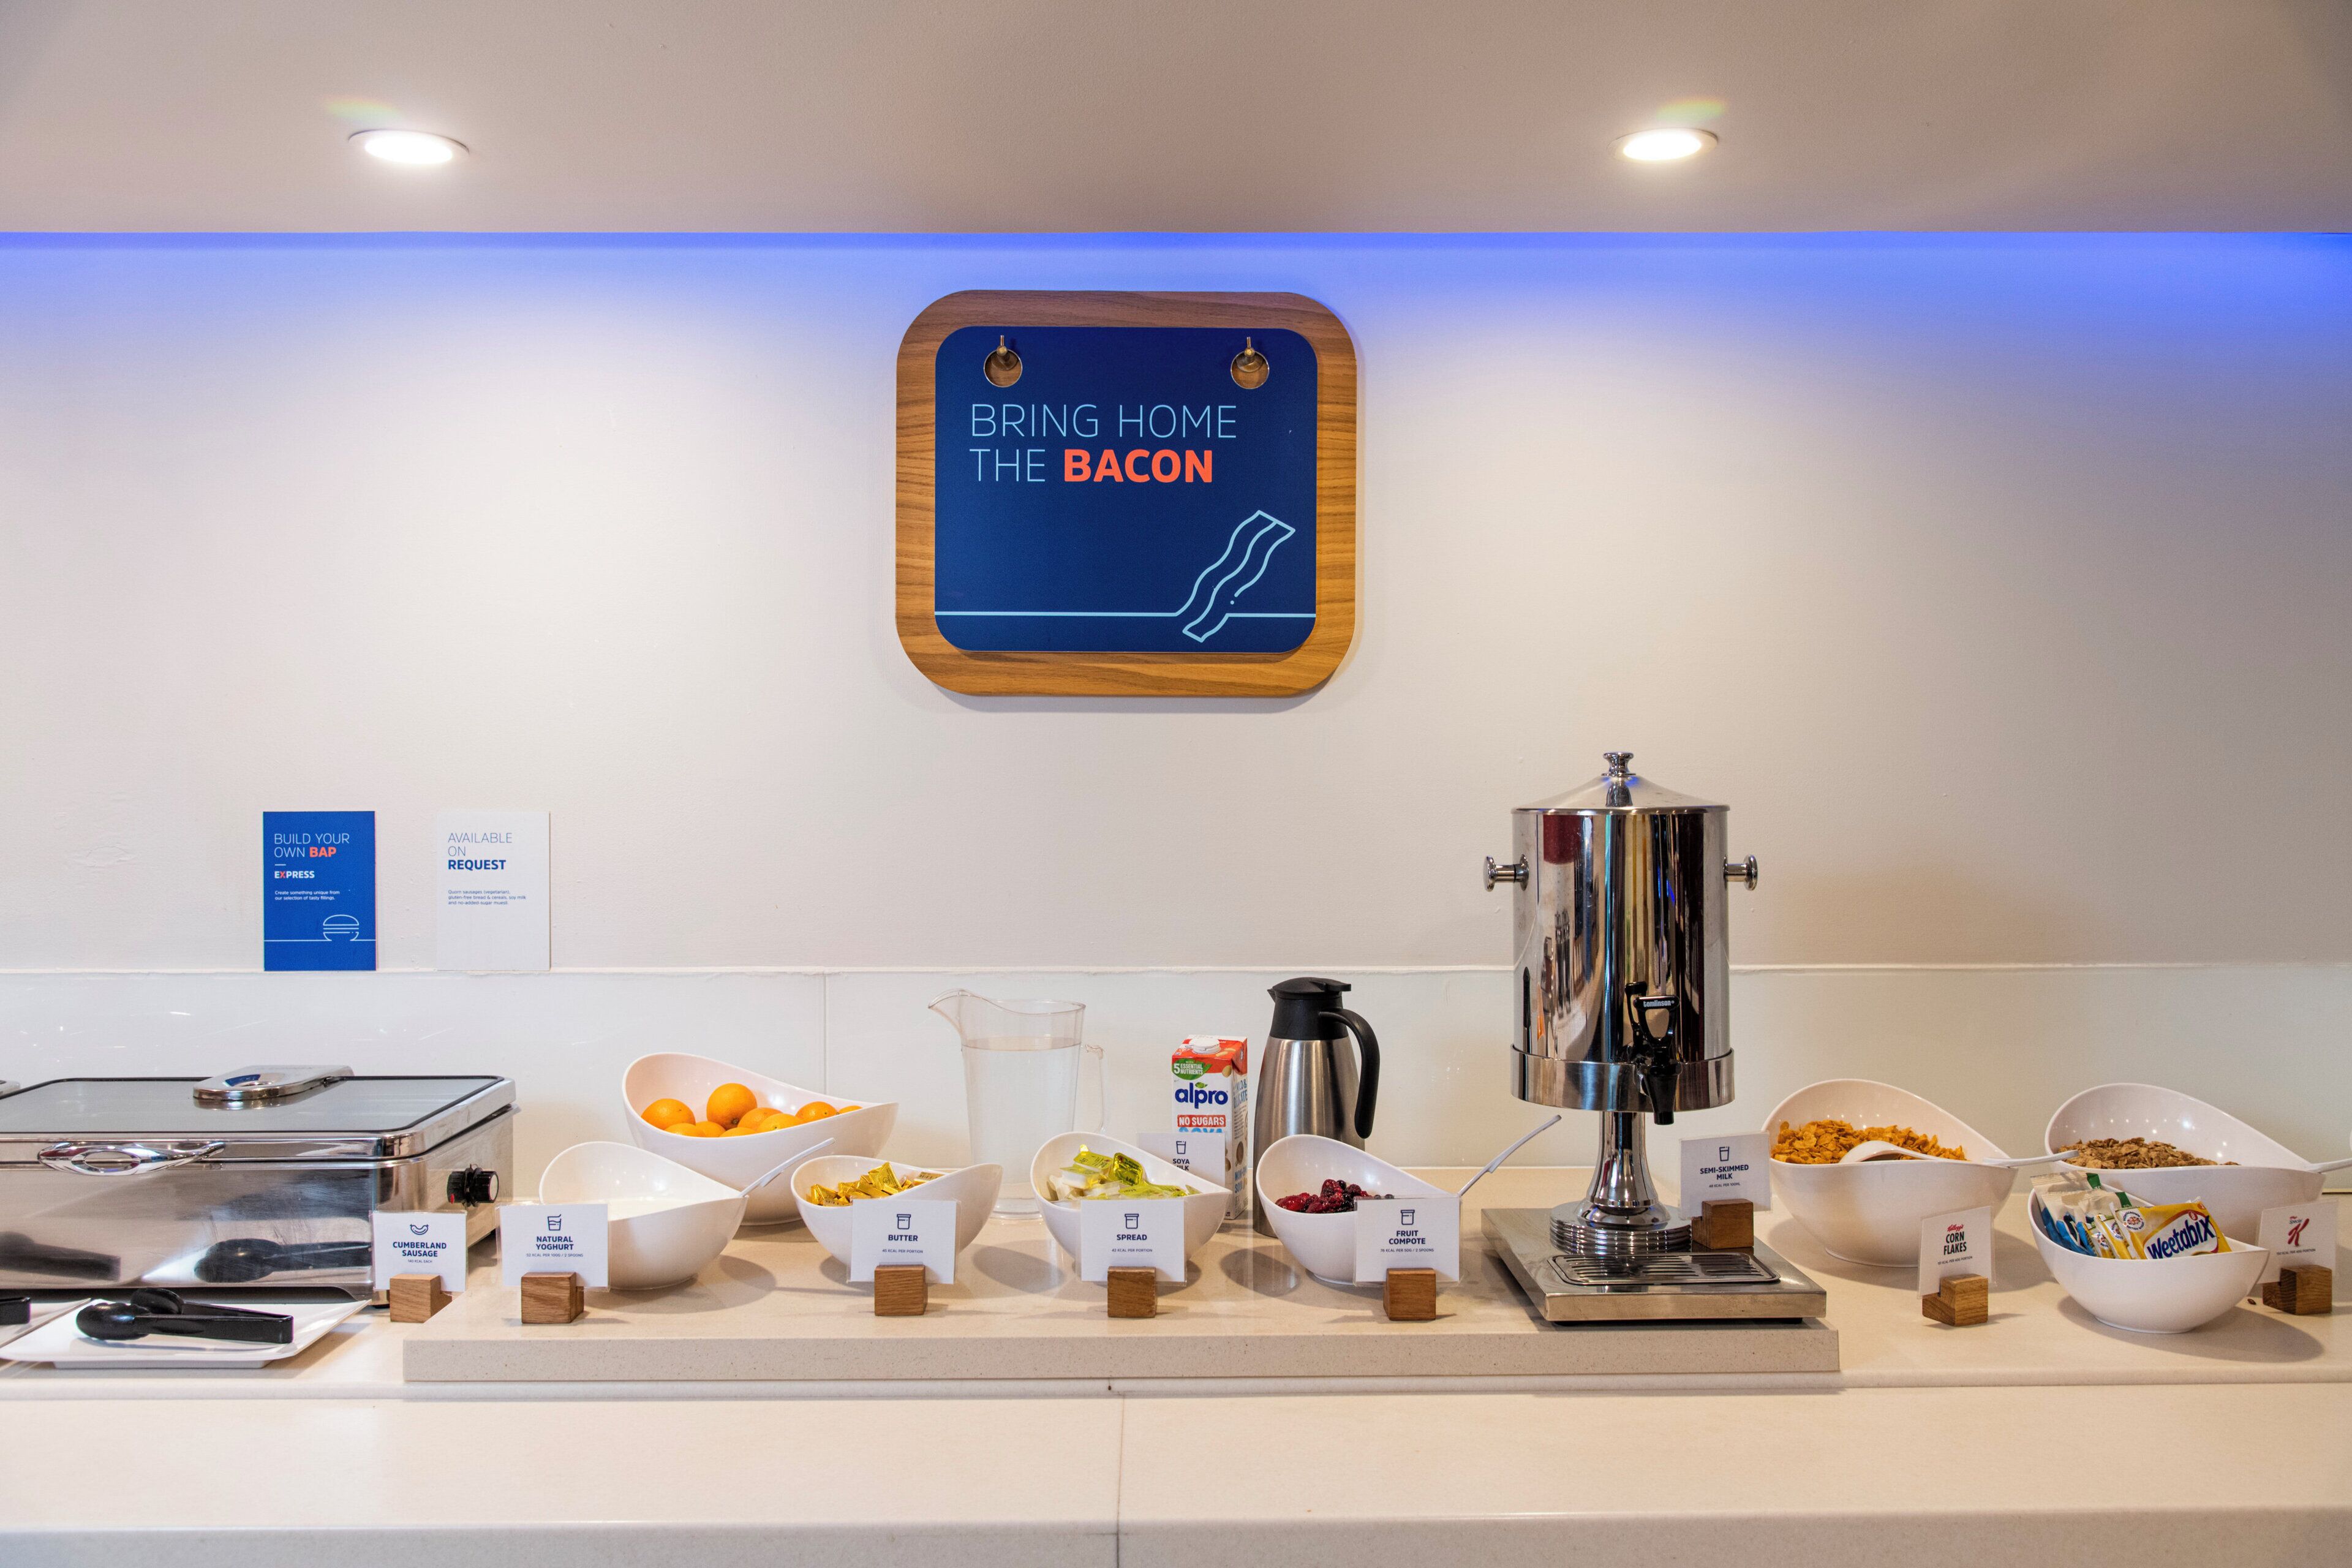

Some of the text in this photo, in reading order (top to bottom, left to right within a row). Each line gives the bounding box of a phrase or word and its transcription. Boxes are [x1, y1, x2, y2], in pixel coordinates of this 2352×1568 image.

[971, 404, 1237, 439] BRING HOME
[970, 449, 1213, 483] THE BACON
[274, 833, 350, 844] BUILD YOUR
[448, 832, 513, 843] AVAILABLE
[274, 846, 337, 858] OWN BAP
[448, 846, 466, 856] ON
[448, 859, 507, 871] REQUEST
[274, 870, 315, 879] EXPRESS
[1174, 1063, 1180, 1074] 5
[1175, 1082, 1229, 1109] alpro
[1179, 1117, 1224, 1126] NO SUGARS
[1700, 1164, 1749, 1174] SEMI-SKIMMED
[1946, 1231, 1964, 1243] CORN
[2147, 1215, 2215, 1259] Weetabix
[2288, 1218, 2310, 1246] K
[1943, 1242, 1967, 1255] FLAKES
